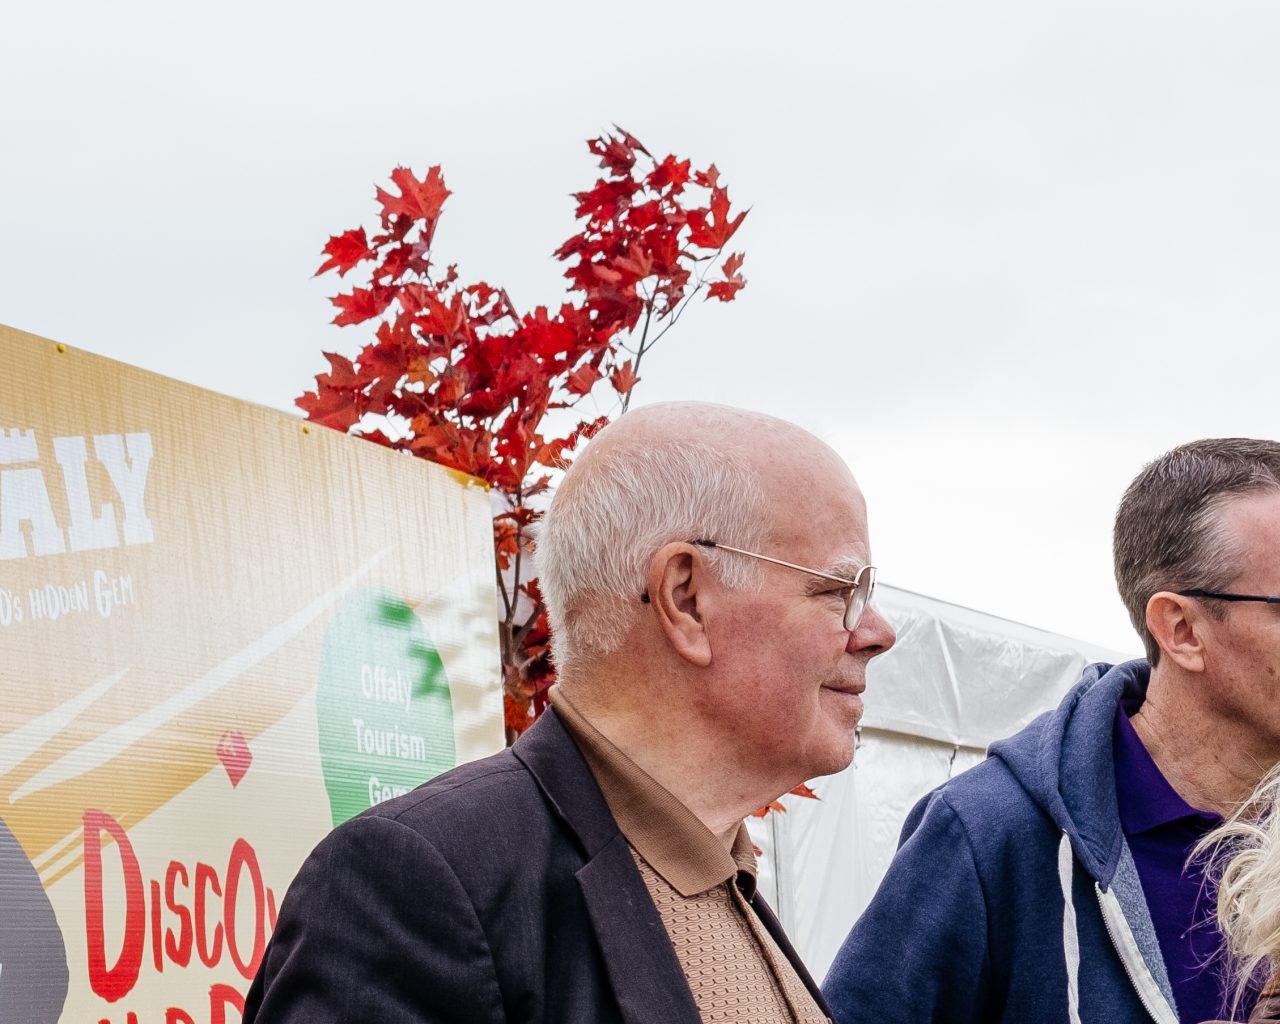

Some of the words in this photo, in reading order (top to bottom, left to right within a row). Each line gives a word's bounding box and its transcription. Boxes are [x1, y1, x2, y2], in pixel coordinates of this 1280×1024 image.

[360, 663, 413, 712] Offaly
[352, 719, 426, 761] Tourism
[368, 775, 411, 807] Ge
